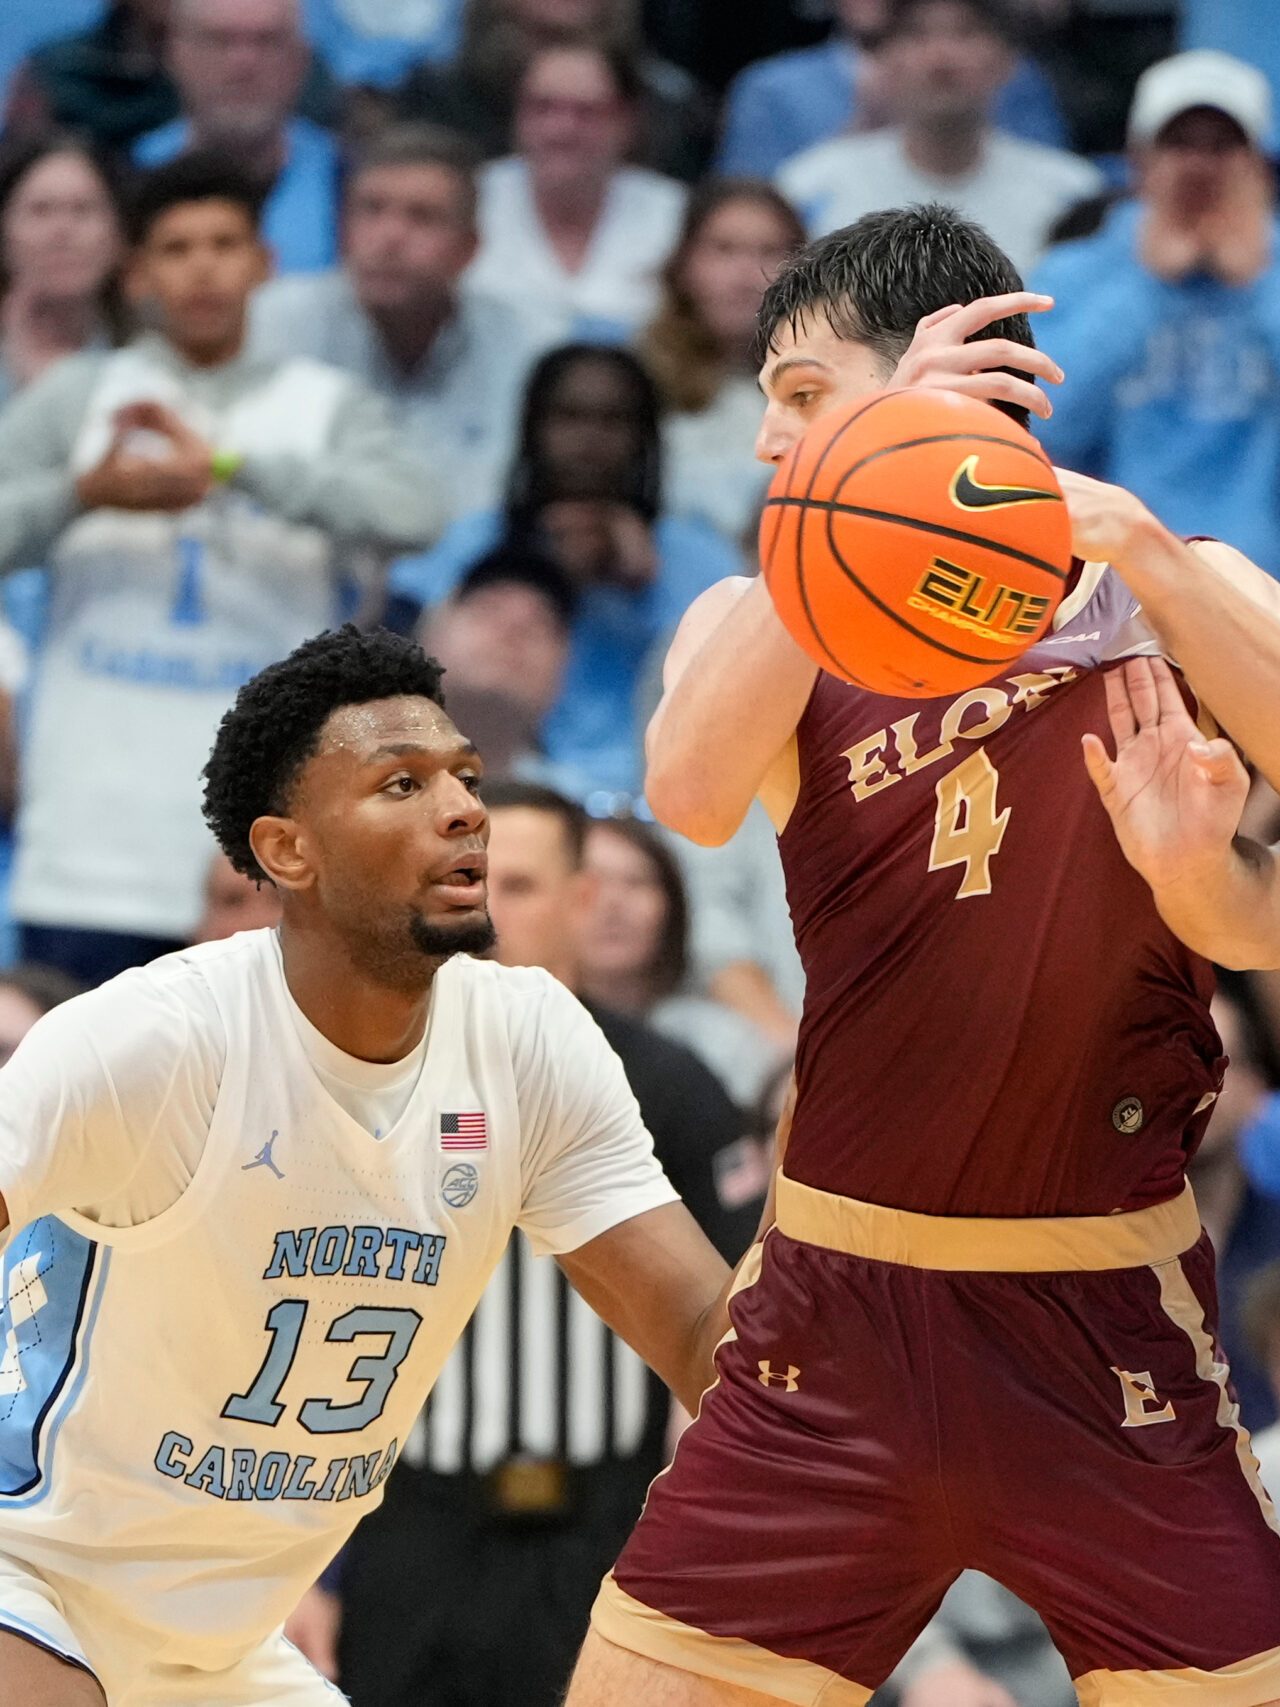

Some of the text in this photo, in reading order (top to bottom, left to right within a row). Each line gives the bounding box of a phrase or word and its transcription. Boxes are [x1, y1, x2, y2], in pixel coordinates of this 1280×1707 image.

[913, 555, 1051, 635] ELITE
[839, 666, 1077, 803] ELON
[927, 745, 1012, 900] 4
[262, 1225, 447, 1286] NORTH
[220, 1299, 424, 1434] 13
[1109, 1366, 1177, 1428] E
[154, 1430, 398, 1502] CAROLINA
